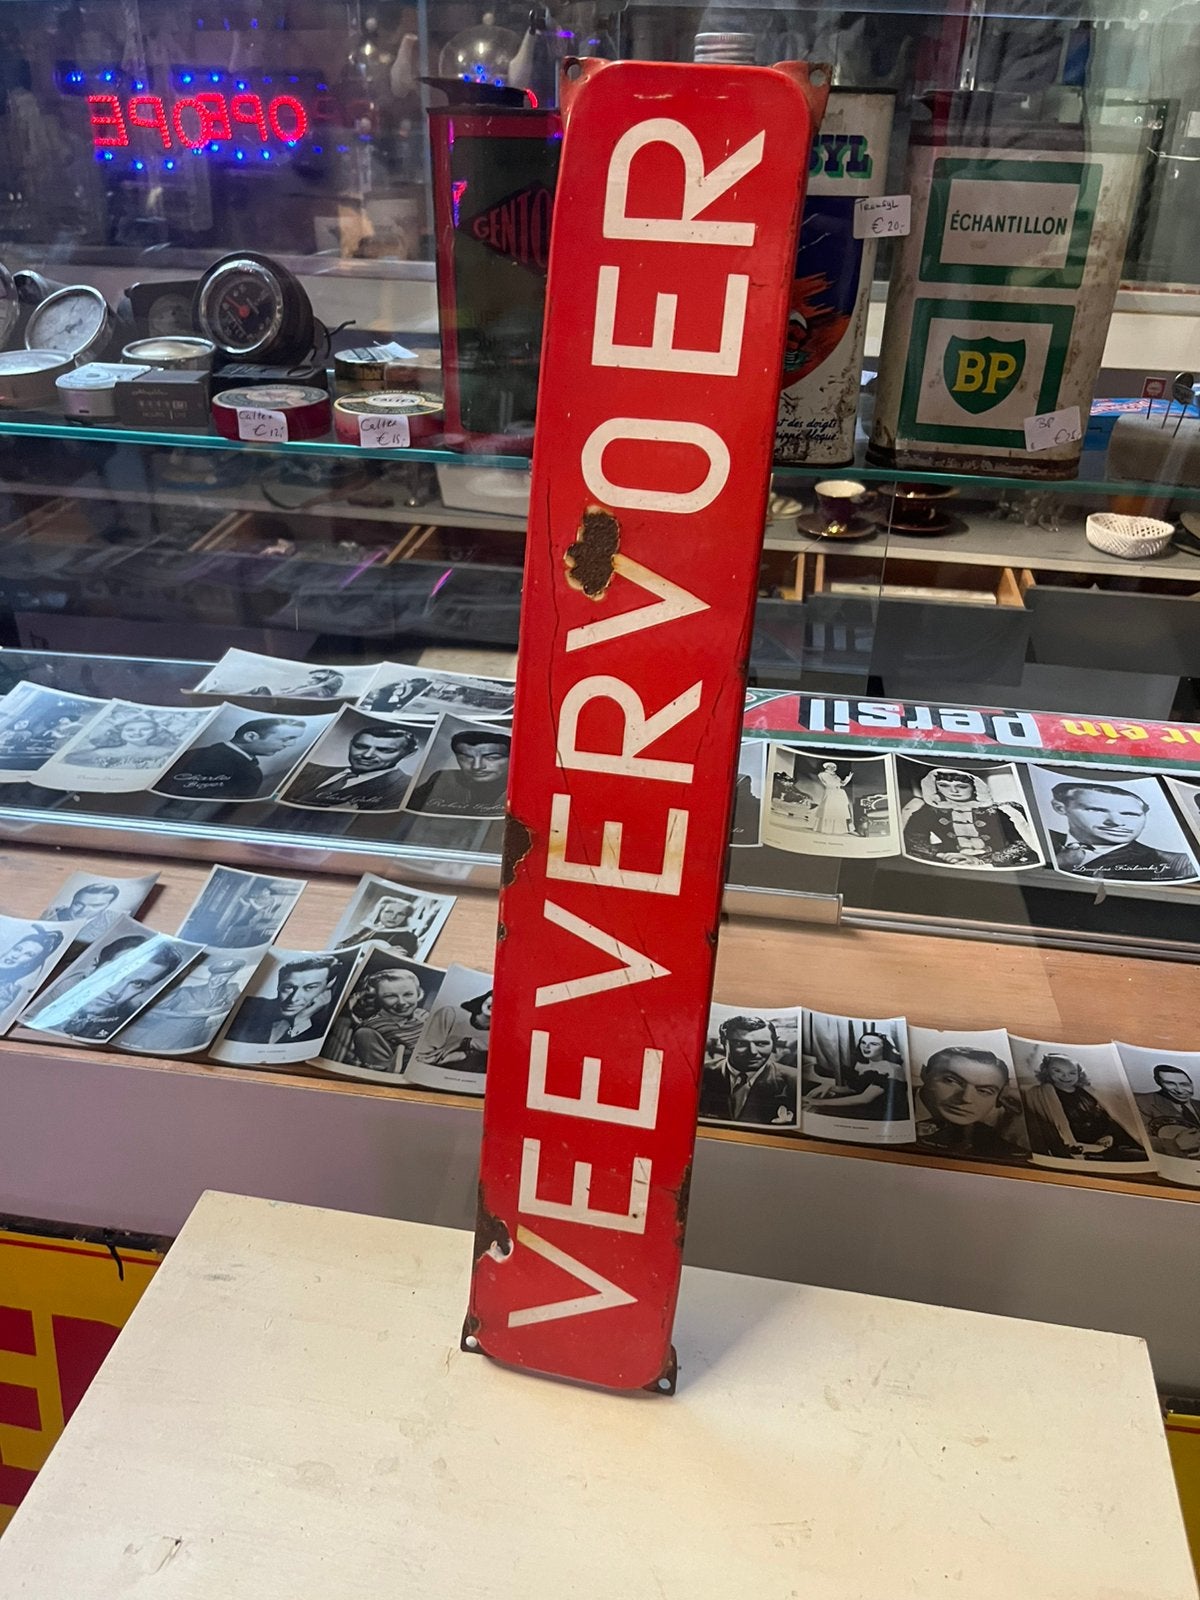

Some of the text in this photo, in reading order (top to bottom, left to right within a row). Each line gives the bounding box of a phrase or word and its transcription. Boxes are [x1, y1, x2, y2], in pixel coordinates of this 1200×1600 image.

[950, 210, 1067, 235] ÉCHANTILLON
[952, 350, 1017, 394] BP
[508, 117, 766, 1328] VEEVERVOER
[808, 698, 1043, 748] Persil
[1060, 719, 1149, 745] ein
